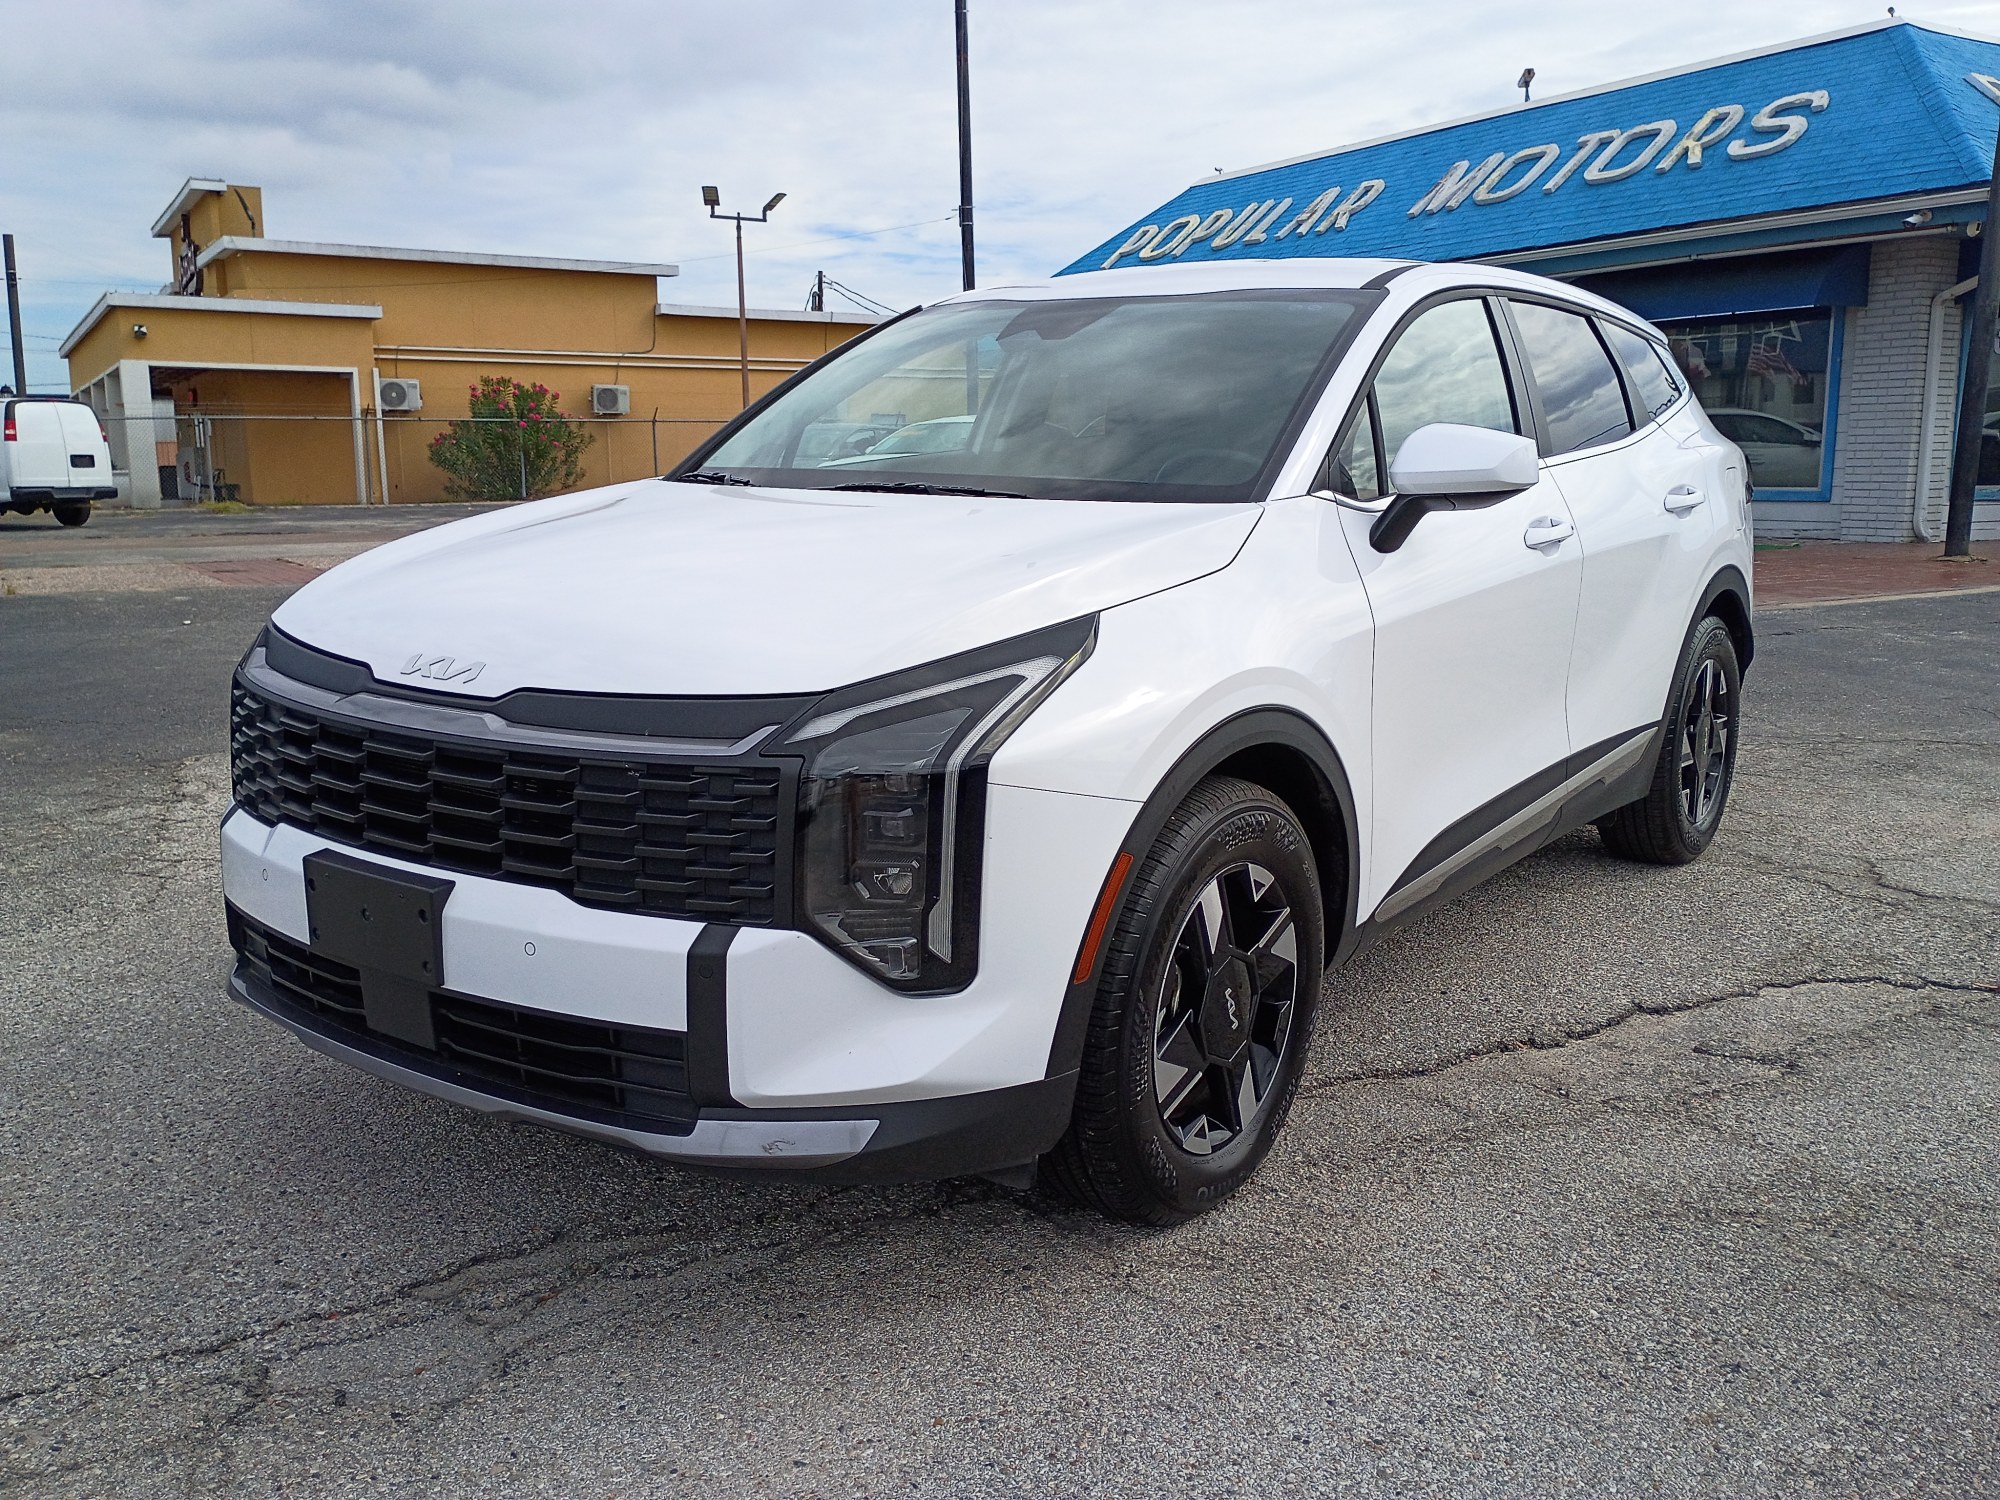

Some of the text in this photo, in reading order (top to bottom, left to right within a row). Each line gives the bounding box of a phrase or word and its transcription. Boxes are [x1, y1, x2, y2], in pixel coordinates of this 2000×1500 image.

[1100, 89, 1830, 271] POPULAR MOTORS
[399, 653, 487, 685] KIA
